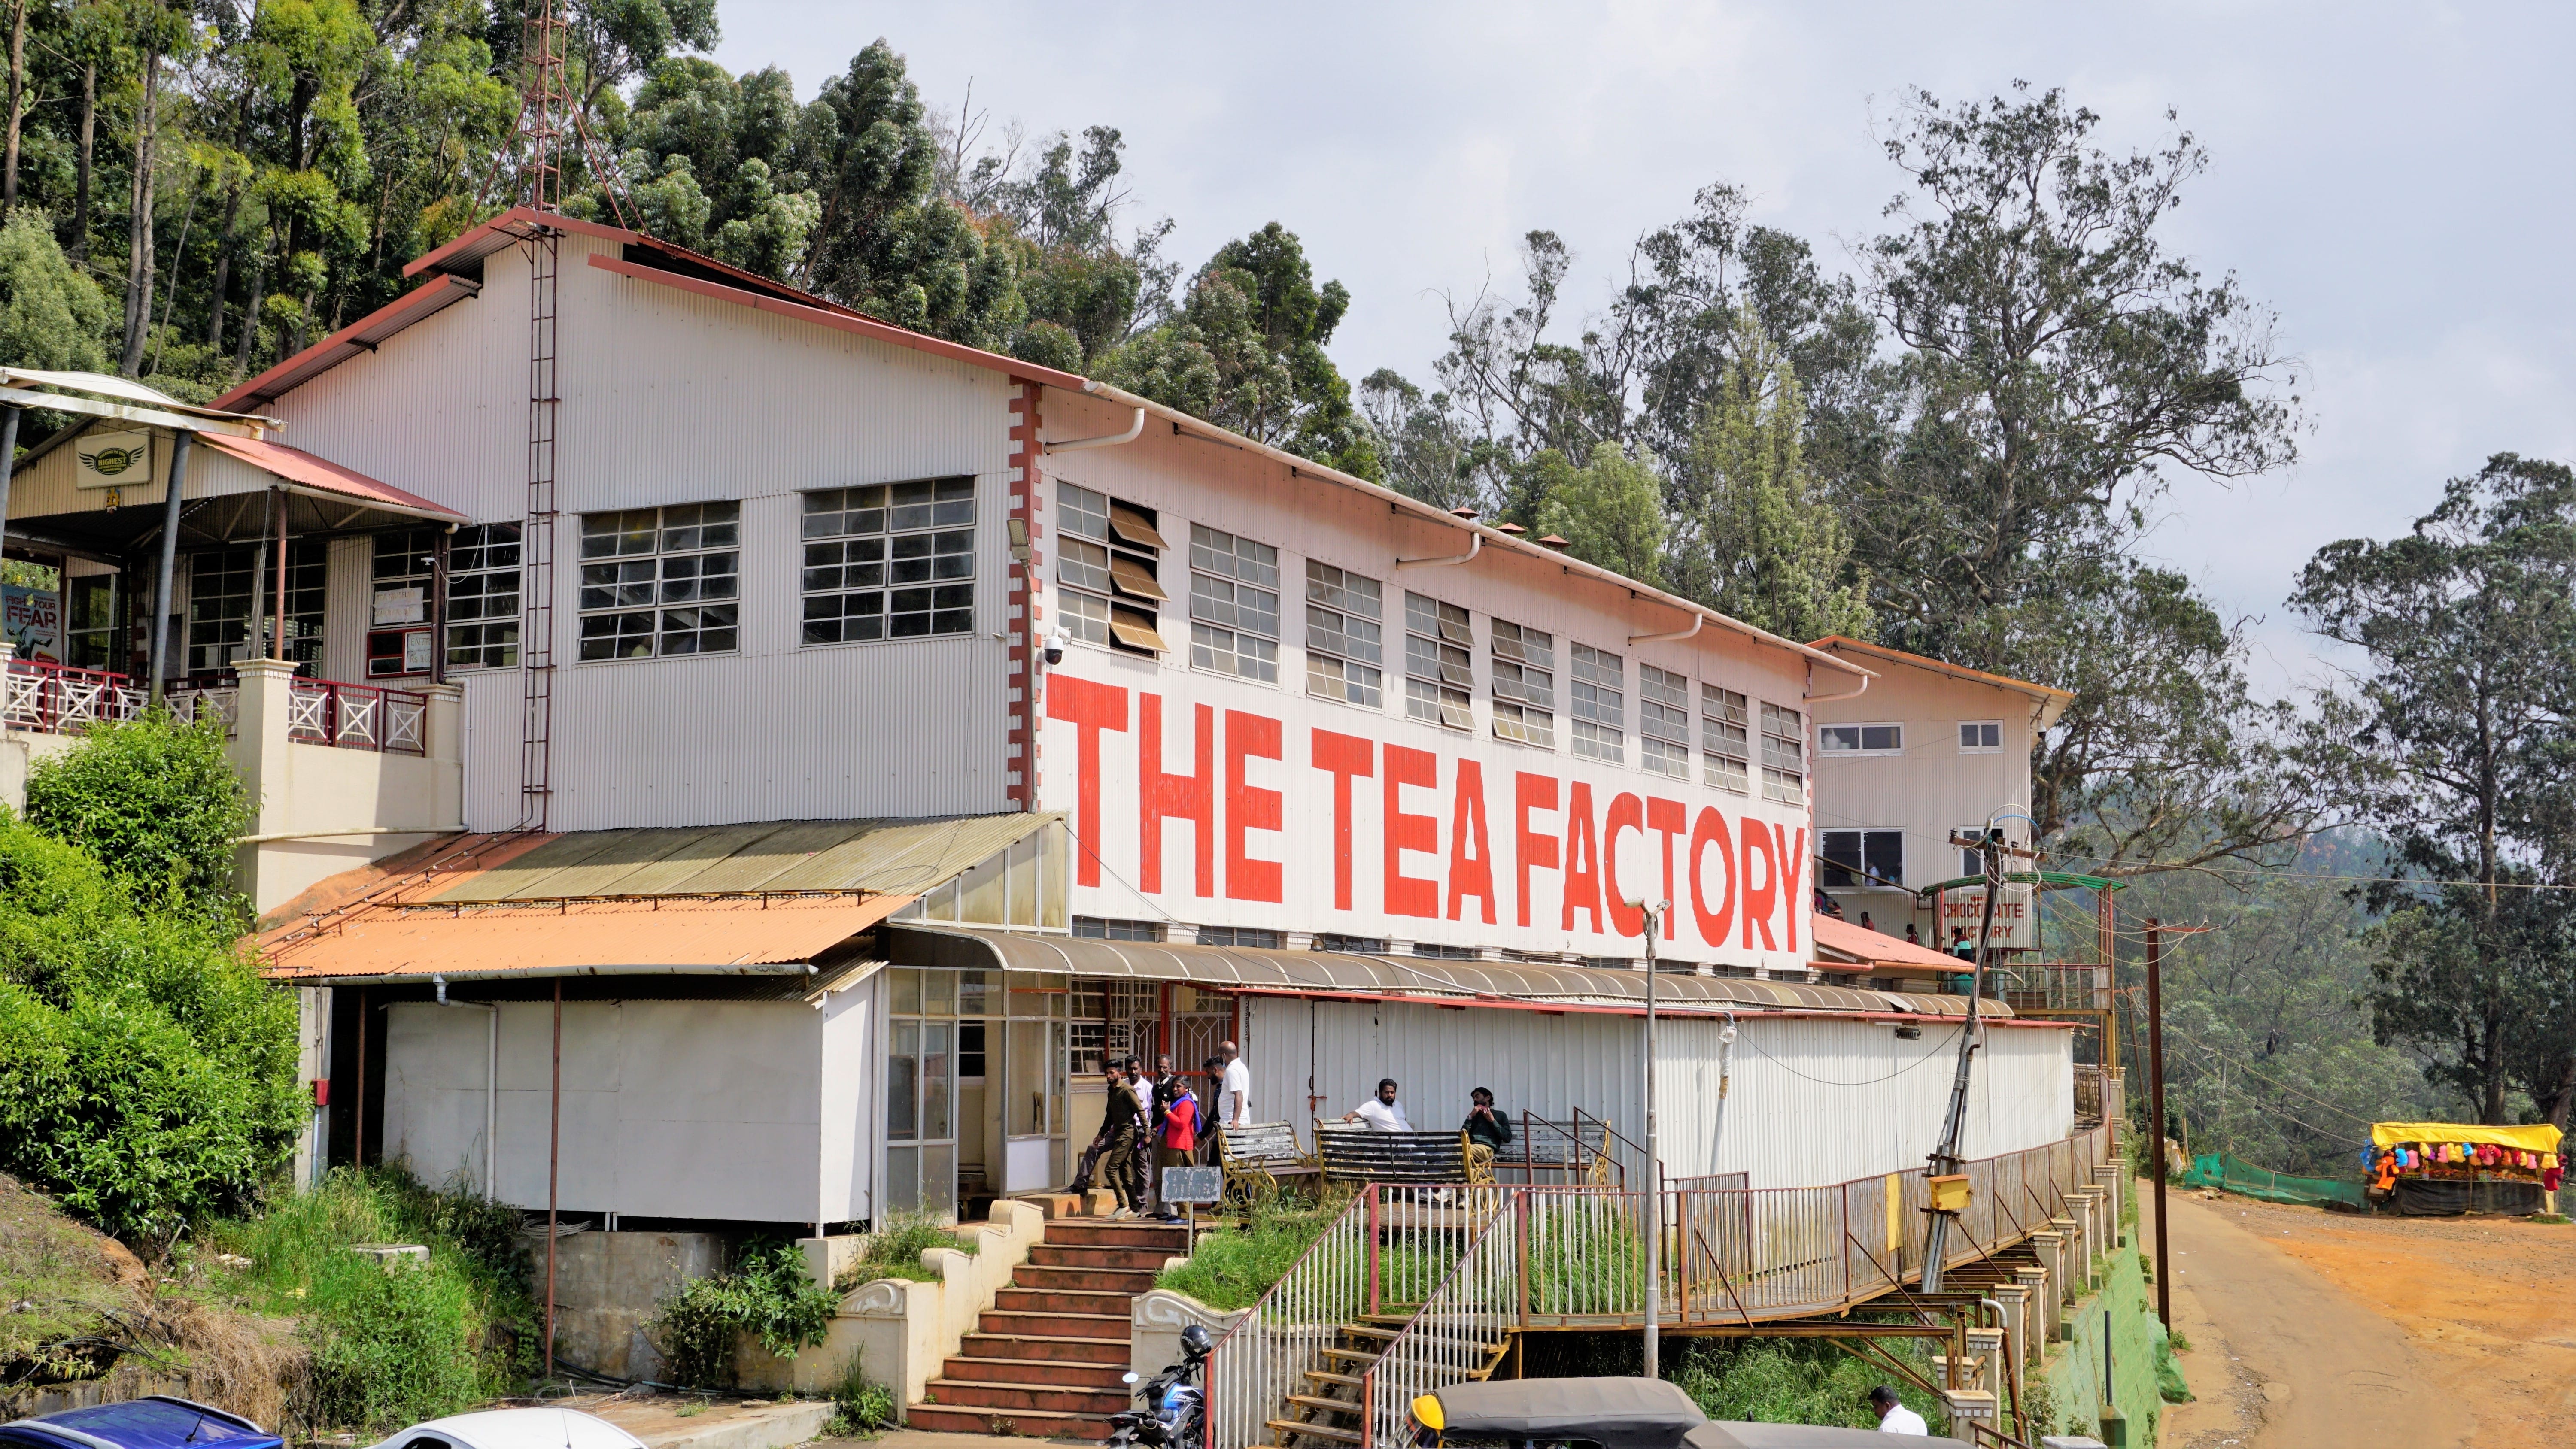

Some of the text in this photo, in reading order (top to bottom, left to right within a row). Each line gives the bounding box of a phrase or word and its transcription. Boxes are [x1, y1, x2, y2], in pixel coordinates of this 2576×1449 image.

[98, 457, 127, 466] HIGHEST
[6, 595, 31, 606] FIGH
[34, 600, 55, 610] YOUR
[7, 606, 57, 629] FEAR
[410, 637, 431, 646] ENTR
[1047, 673, 1804, 952] THE TEA FACTORY
[1944, 903, 2023, 918] CHOCOATE
[1173, 1393, 1200, 1402] HORNET
